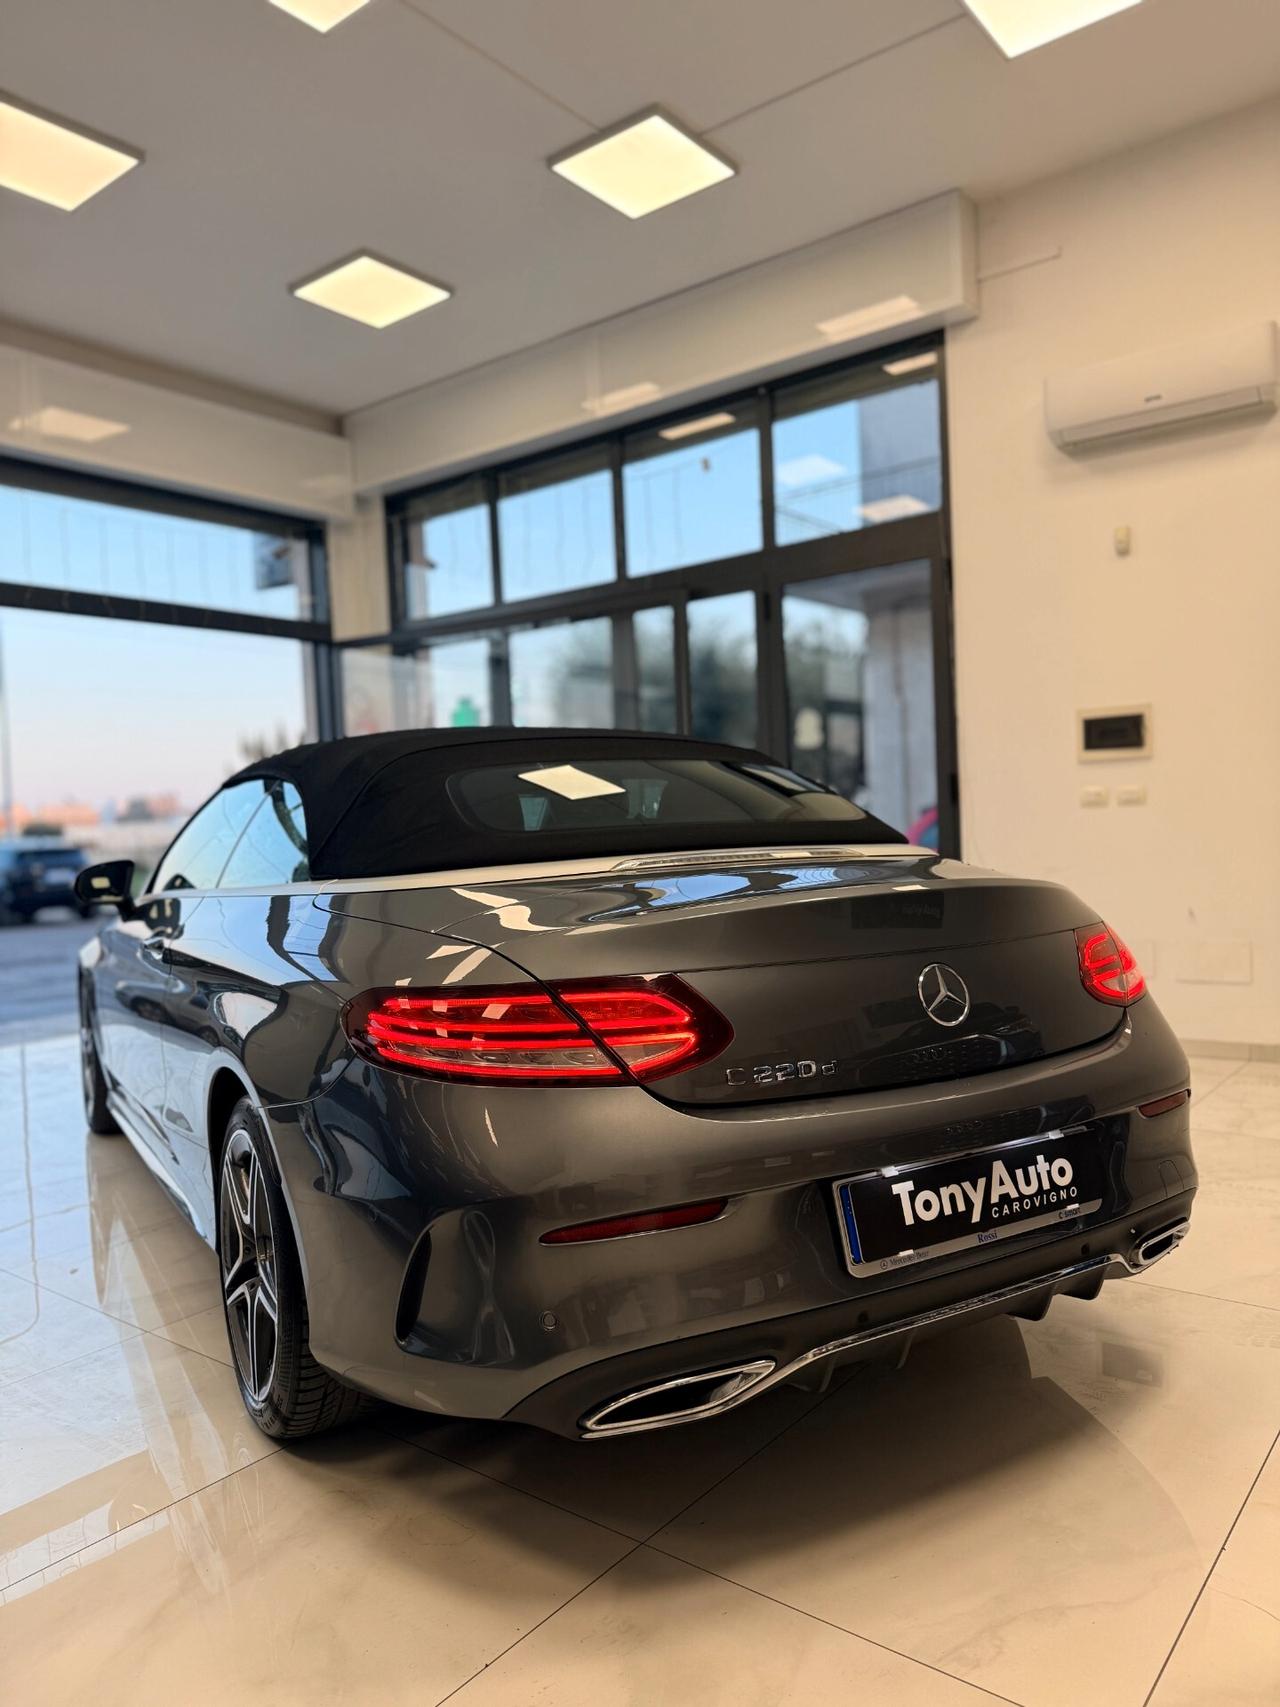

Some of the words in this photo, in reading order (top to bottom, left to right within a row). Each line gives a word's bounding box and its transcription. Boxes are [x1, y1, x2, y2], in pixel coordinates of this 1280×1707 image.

[726, 1068, 746, 1086] C
[753, 1060, 817, 1083] 220
[821, 1059, 838, 1076] d
[991, 1185, 1078, 1219] CAROVIGNO
